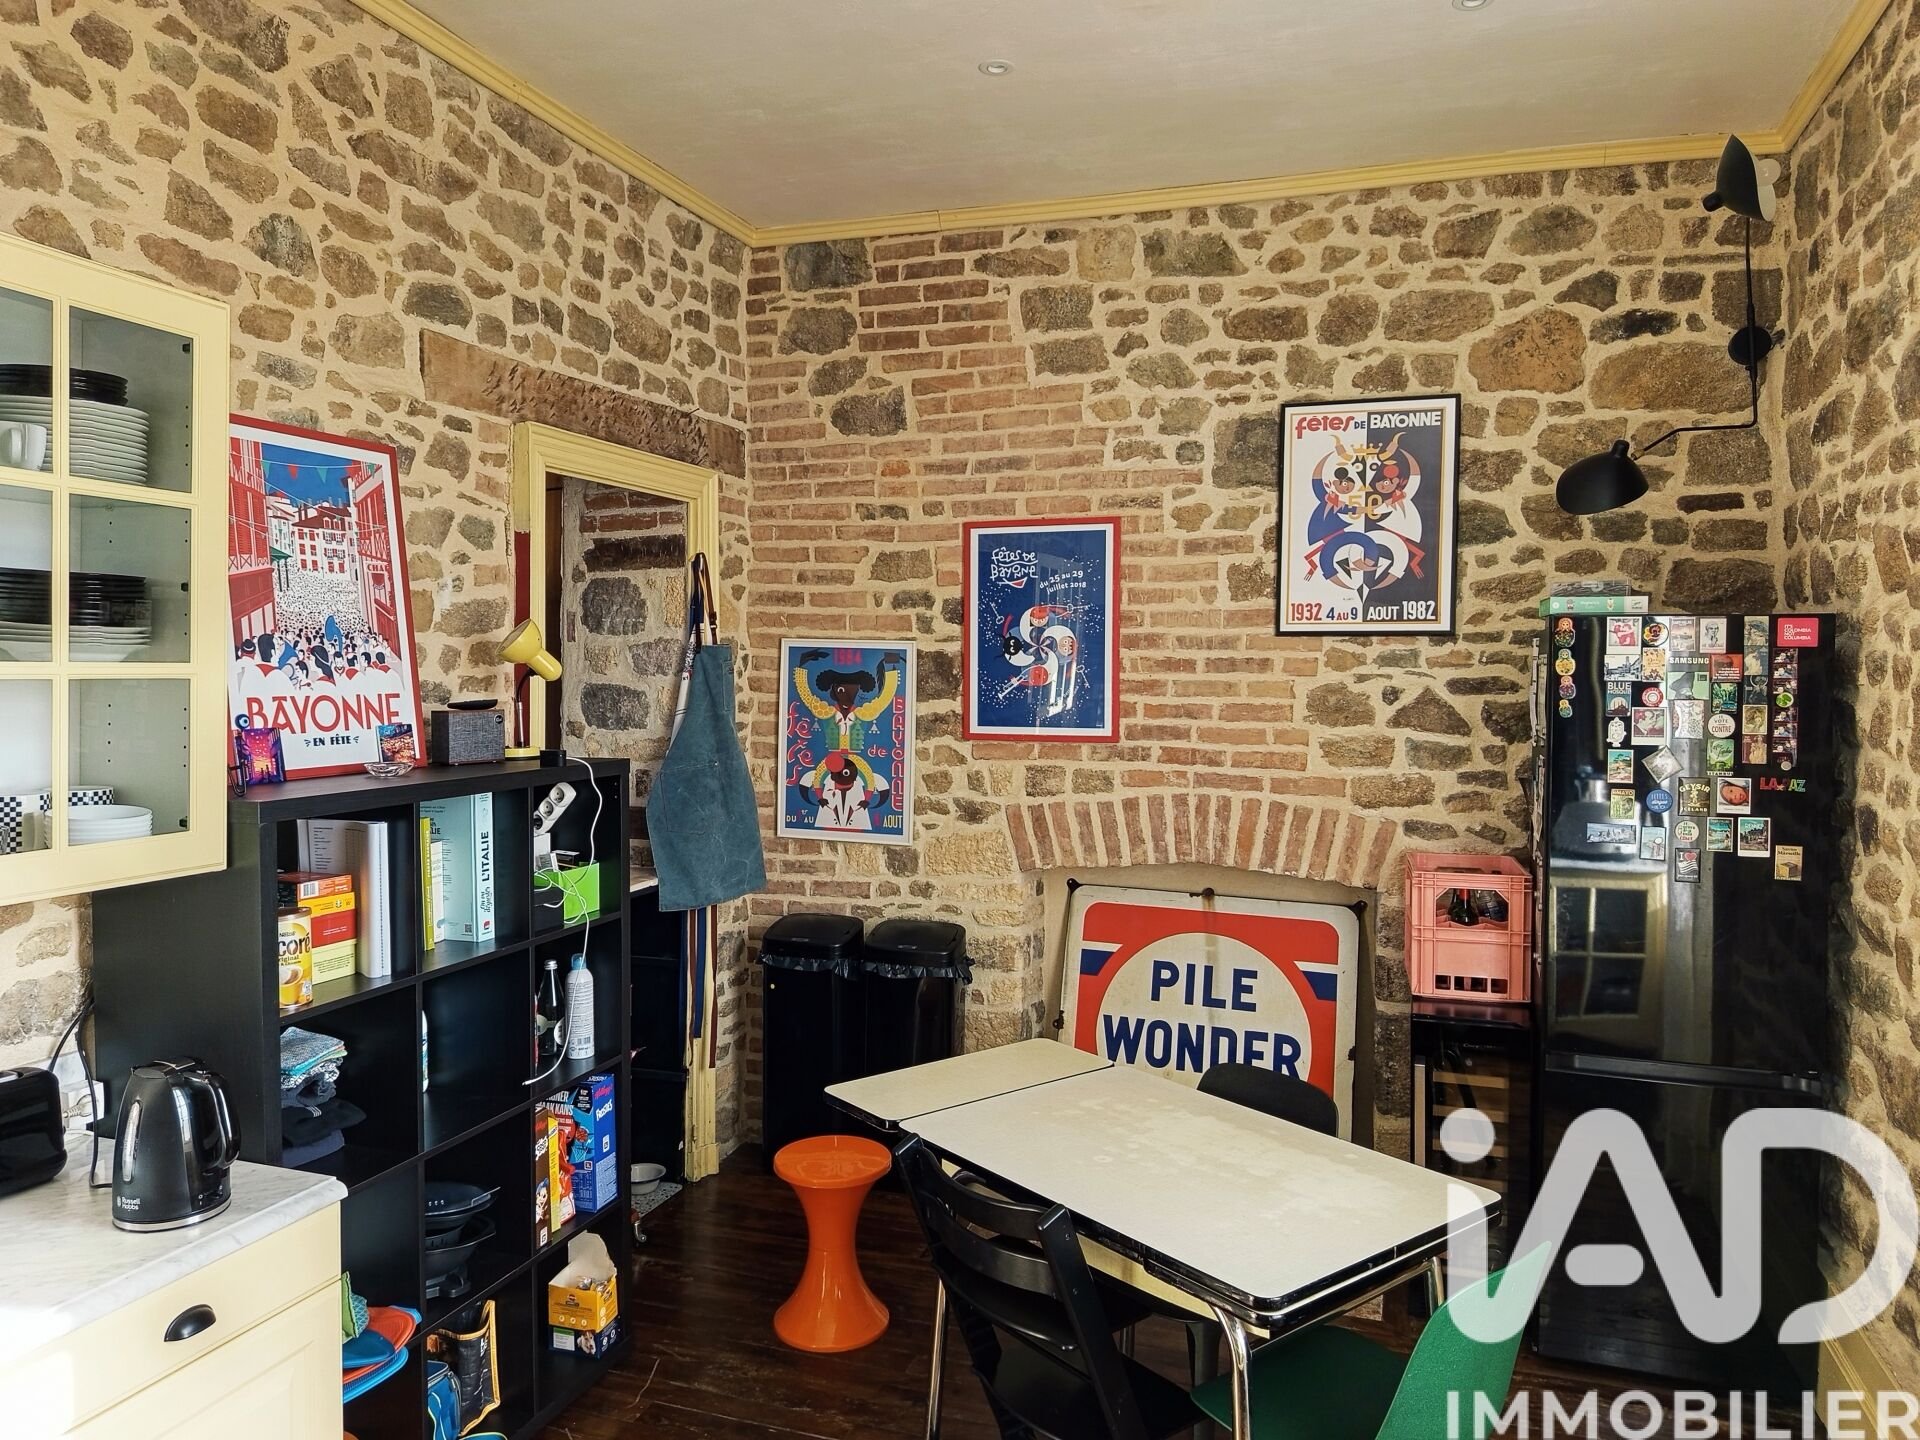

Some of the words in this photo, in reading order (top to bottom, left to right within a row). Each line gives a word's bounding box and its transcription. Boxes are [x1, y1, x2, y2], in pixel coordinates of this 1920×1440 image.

[1355, 421, 1366, 429] DE
[1370, 411, 1442, 429] BAYONNE
[1039, 580, 1049, 589] du
[1049, 574, 1060, 583] 25
[1071, 570, 1084, 578] 29
[1046, 582, 1069, 595] juillet
[1291, 602, 1322, 621] 1932
[1326, 606, 1336, 621] 4
[1336, 612, 1349, 621] AU
[1350, 606, 1358, 621] 9
[1367, 605, 1400, 621] AOUT
[1402, 600, 1436, 620] 1982
[1607, 682, 1632, 690] BLUE
[246, 693, 401, 734] BAYONNE
[1711, 725, 1732, 733] CONTRE
[313, 737, 325, 746] EN
[330, 733, 351, 746] FÊTE
[1679, 783, 1711, 793] GEYSIR
[786, 815, 797, 823] DU
[803, 815, 814, 824] AU
[883, 815, 902, 828] AOUT
[480, 831, 490, 882] L'ITALIE
[1150, 959, 1258, 1012] PILE
[1103, 1014, 1302, 1080] WONDER
